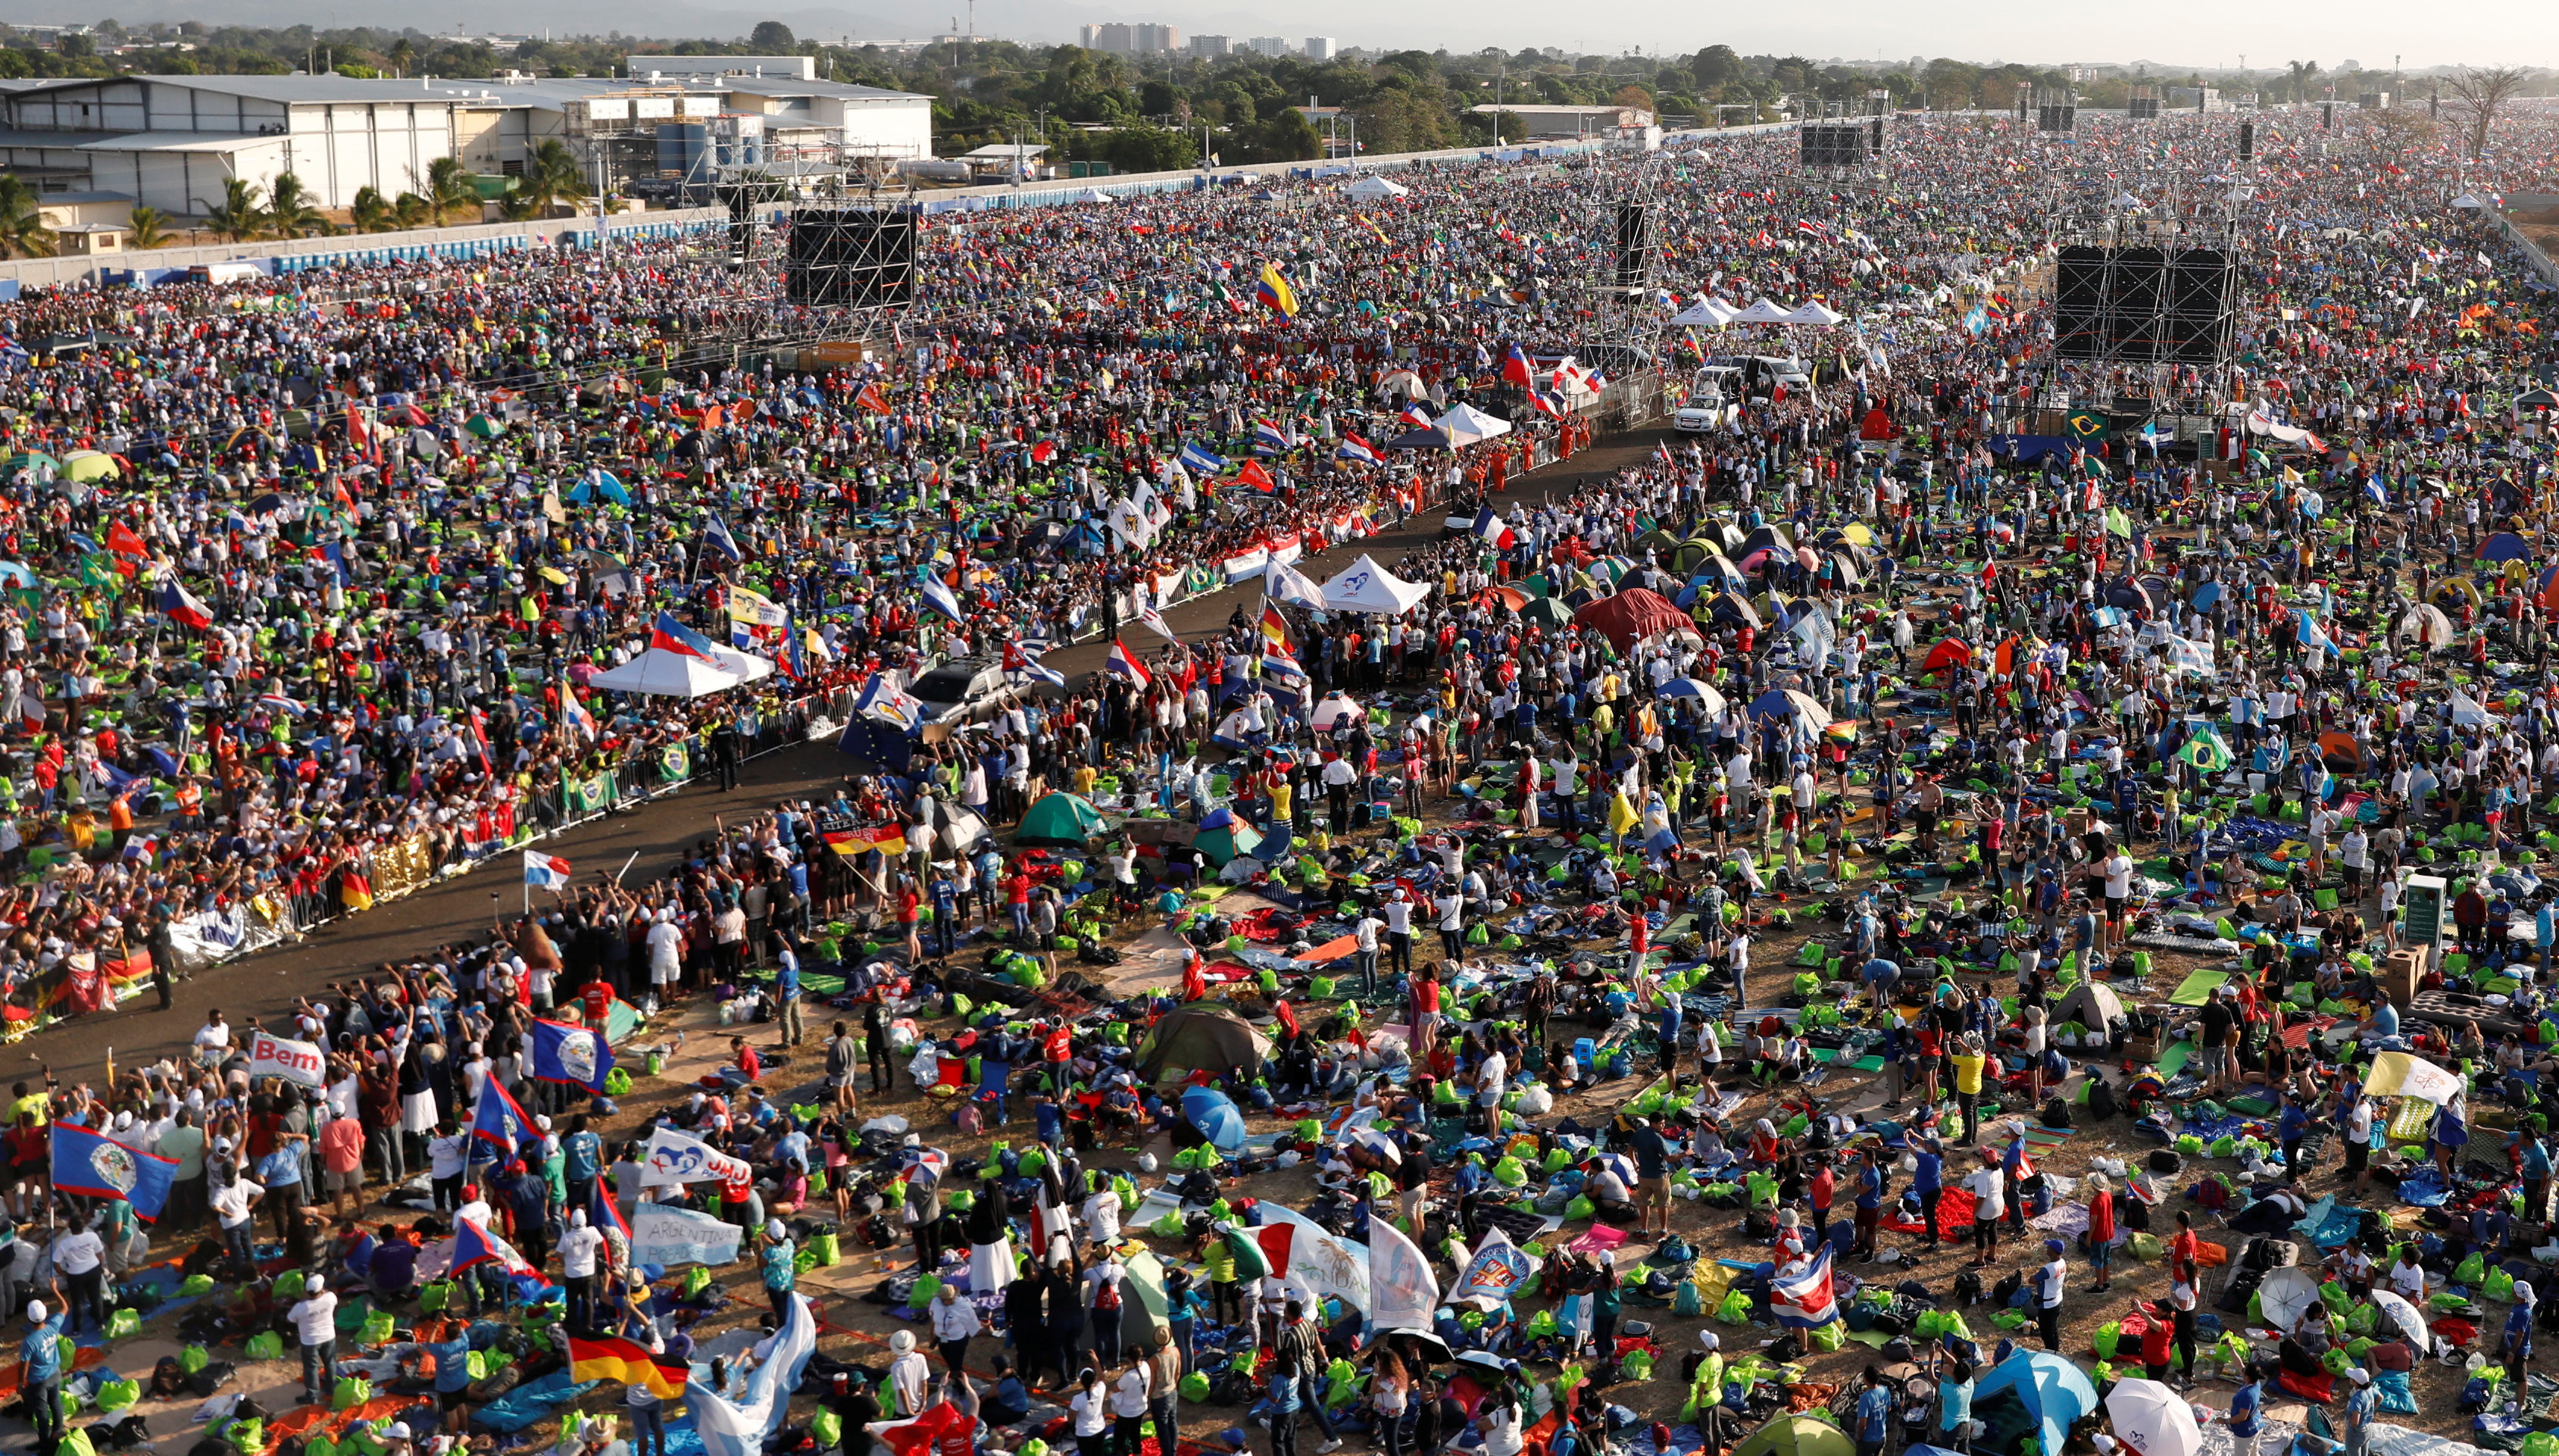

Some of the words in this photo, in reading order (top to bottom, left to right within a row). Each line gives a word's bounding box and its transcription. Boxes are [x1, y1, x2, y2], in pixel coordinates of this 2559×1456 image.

[714, 118, 732, 136] A1
[1612, 130, 1636, 148] A2
[758, 612, 776, 621] 2019
[2380, 660, 2386, 669] 3
[255, 1040, 317, 1070] Bem
[708, 1159, 748, 1181] JMJ
[648, 1221, 732, 1245] ARGENTINA
[1472, 1246, 1510, 1267] DIOCESI
